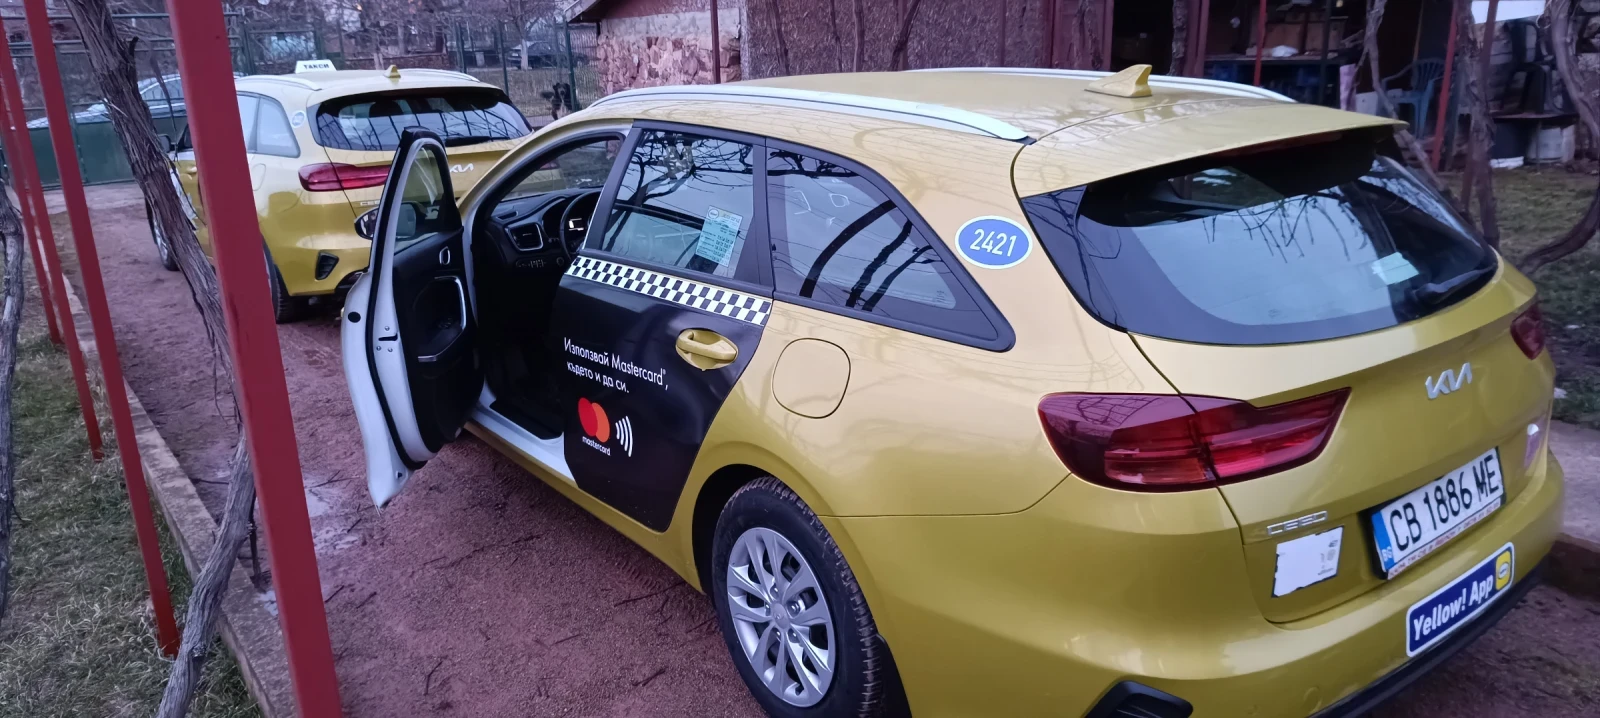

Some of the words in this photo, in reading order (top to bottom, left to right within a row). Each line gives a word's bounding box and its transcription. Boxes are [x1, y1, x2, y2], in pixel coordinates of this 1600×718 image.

[969, 228, 1017, 257] 2421
[563, 337, 610, 367] Използвай
[566, 361, 594, 380] където
[595, 371, 601, 383] и
[602, 374, 614, 388] да
[615, 379, 630, 393] си.
[1425, 362, 1472, 399] KIA
[582, 435, 611, 456] mastercard
[1390, 502, 1422, 551] CB
[1423, 471, 1473, 531] 1886
[1472, 454, 1500, 502] ME
[1413, 587, 1467, 641] Yellow!
[1468, 574, 1494, 606] App
